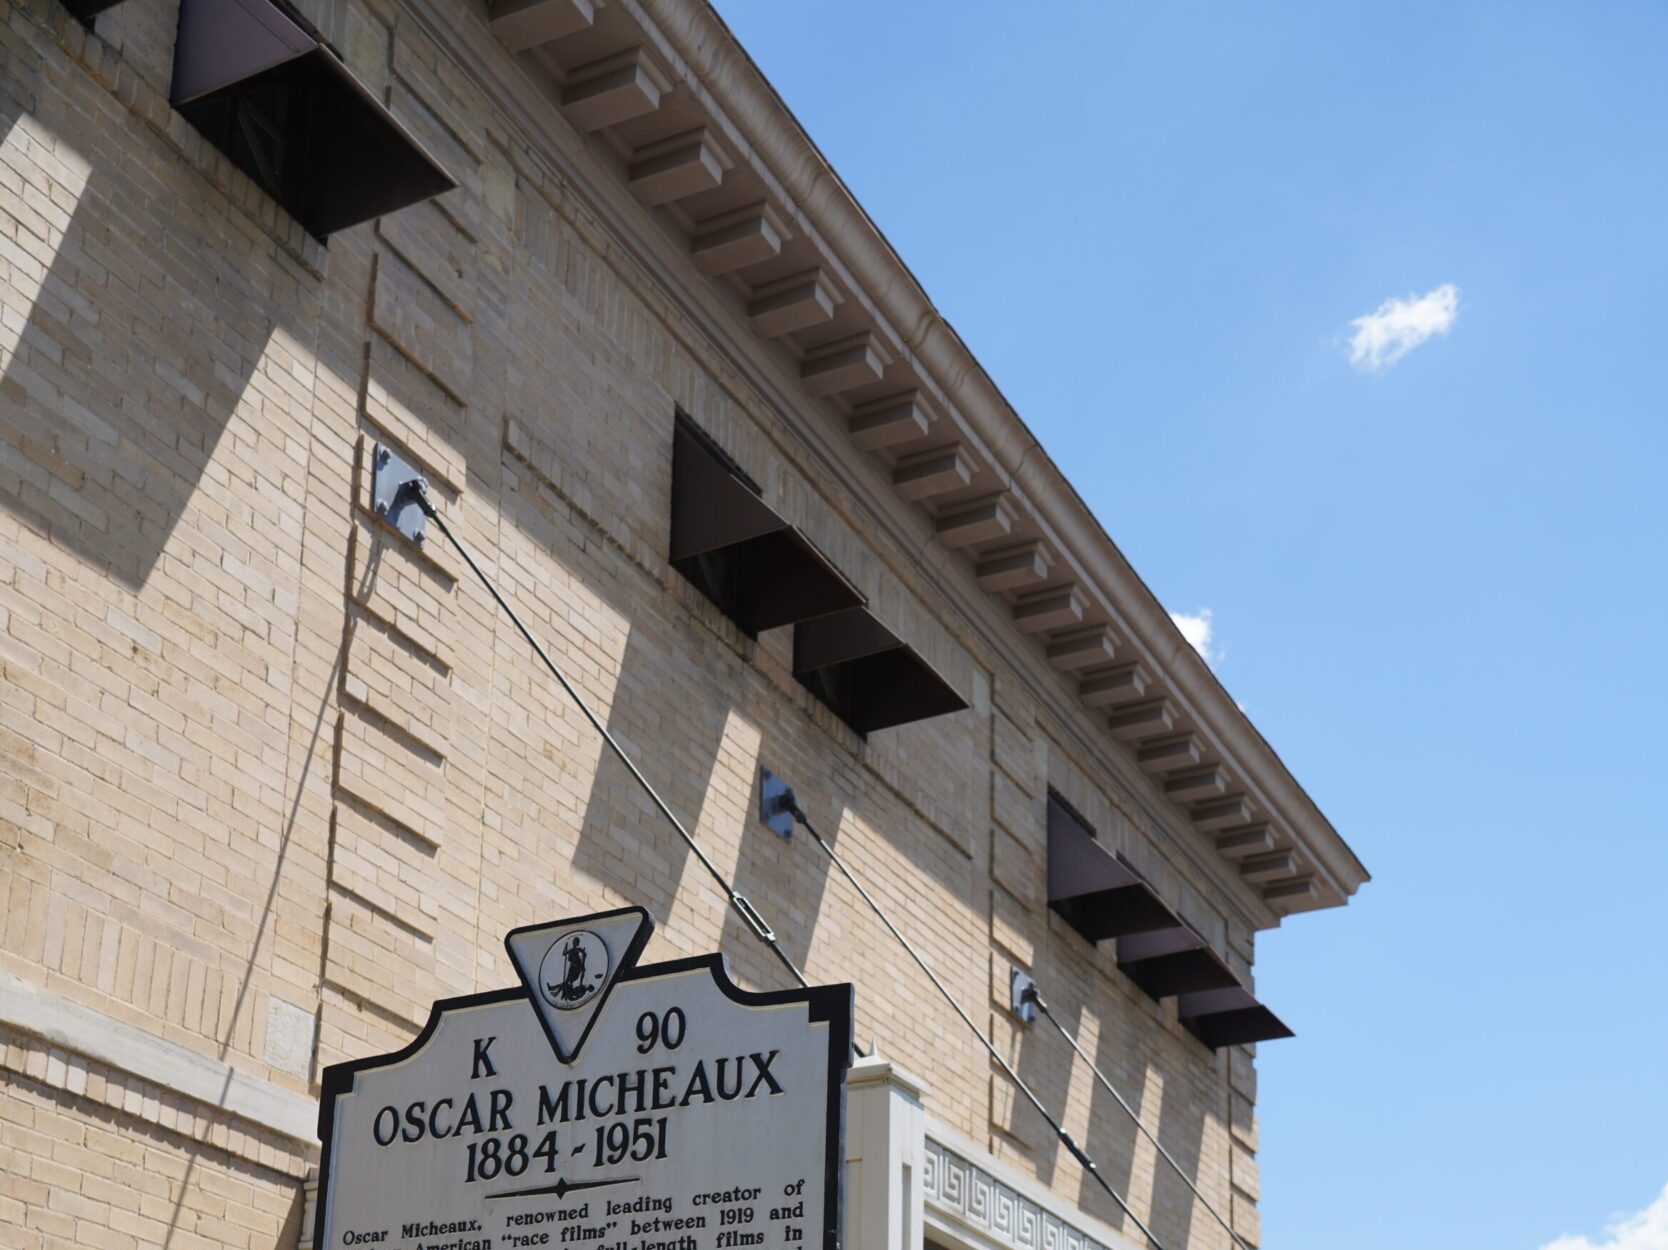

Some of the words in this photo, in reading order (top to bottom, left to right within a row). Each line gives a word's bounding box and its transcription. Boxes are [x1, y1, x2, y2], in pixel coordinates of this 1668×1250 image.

[469, 1035, 498, 1080] K
[635, 1005, 687, 1055] 90
[372, 1088, 514, 1147] OSCAR
[535, 1049, 784, 1126] MICHEAUX
[342, 1229, 389, 1246] Oscar
[400, 1219, 482, 1239] Micheaux,
[505, 1202, 589, 1228] renowned
[605, 1195, 673, 1217] leading
[691, 1185, 762, 1207] creator
[783, 1178, 806, 1197] of
[629, 1215, 706, 1236] between
[719, 1206, 755, 1226] 1919
[768, 1200, 804, 1221] and
[715, 1229, 765, 1249] films
[783, 1224, 803, 1242] in
